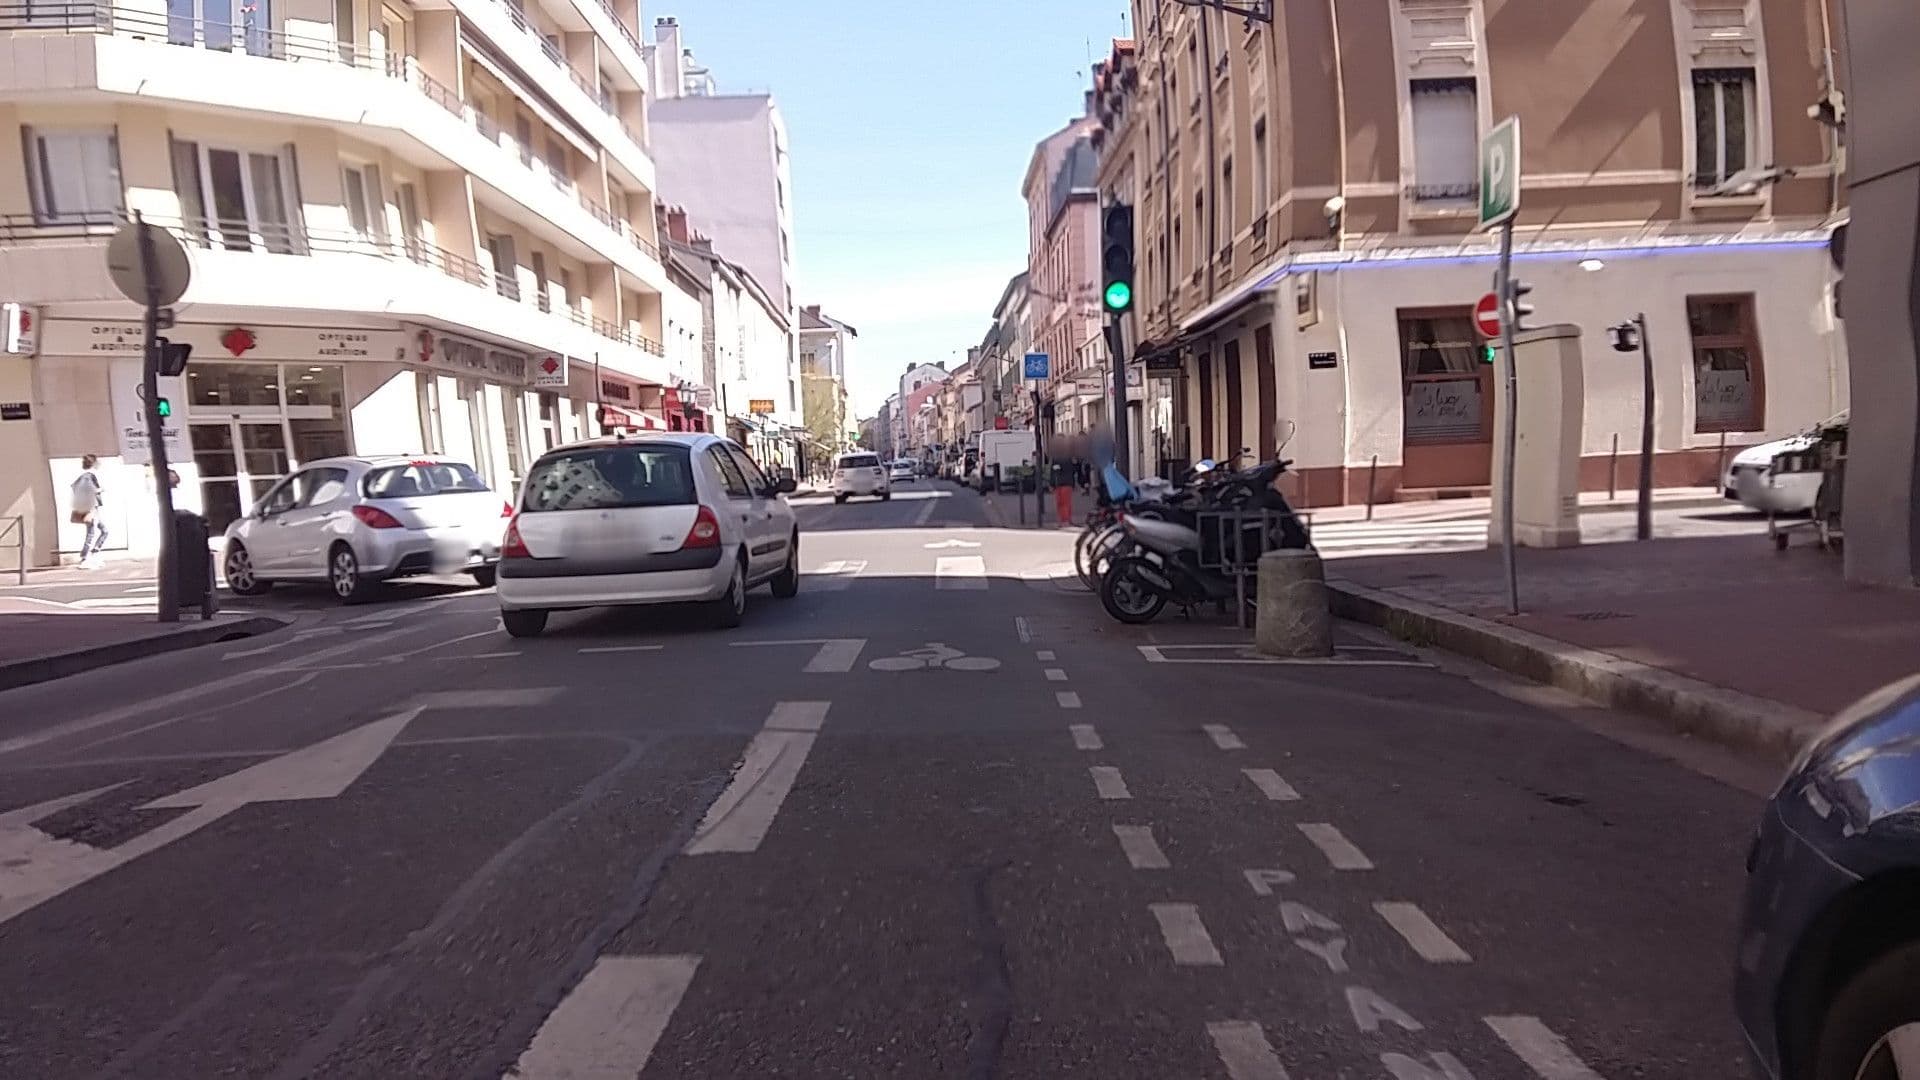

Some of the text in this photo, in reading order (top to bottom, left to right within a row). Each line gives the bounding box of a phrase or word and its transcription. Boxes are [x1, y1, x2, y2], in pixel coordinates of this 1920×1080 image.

[1488, 142, 1506, 205] P
[91, 326, 143, 335] OPTIQU
[318, 333, 368, 342] OPTIQUE
[91, 343, 143, 351] AUDITIO
